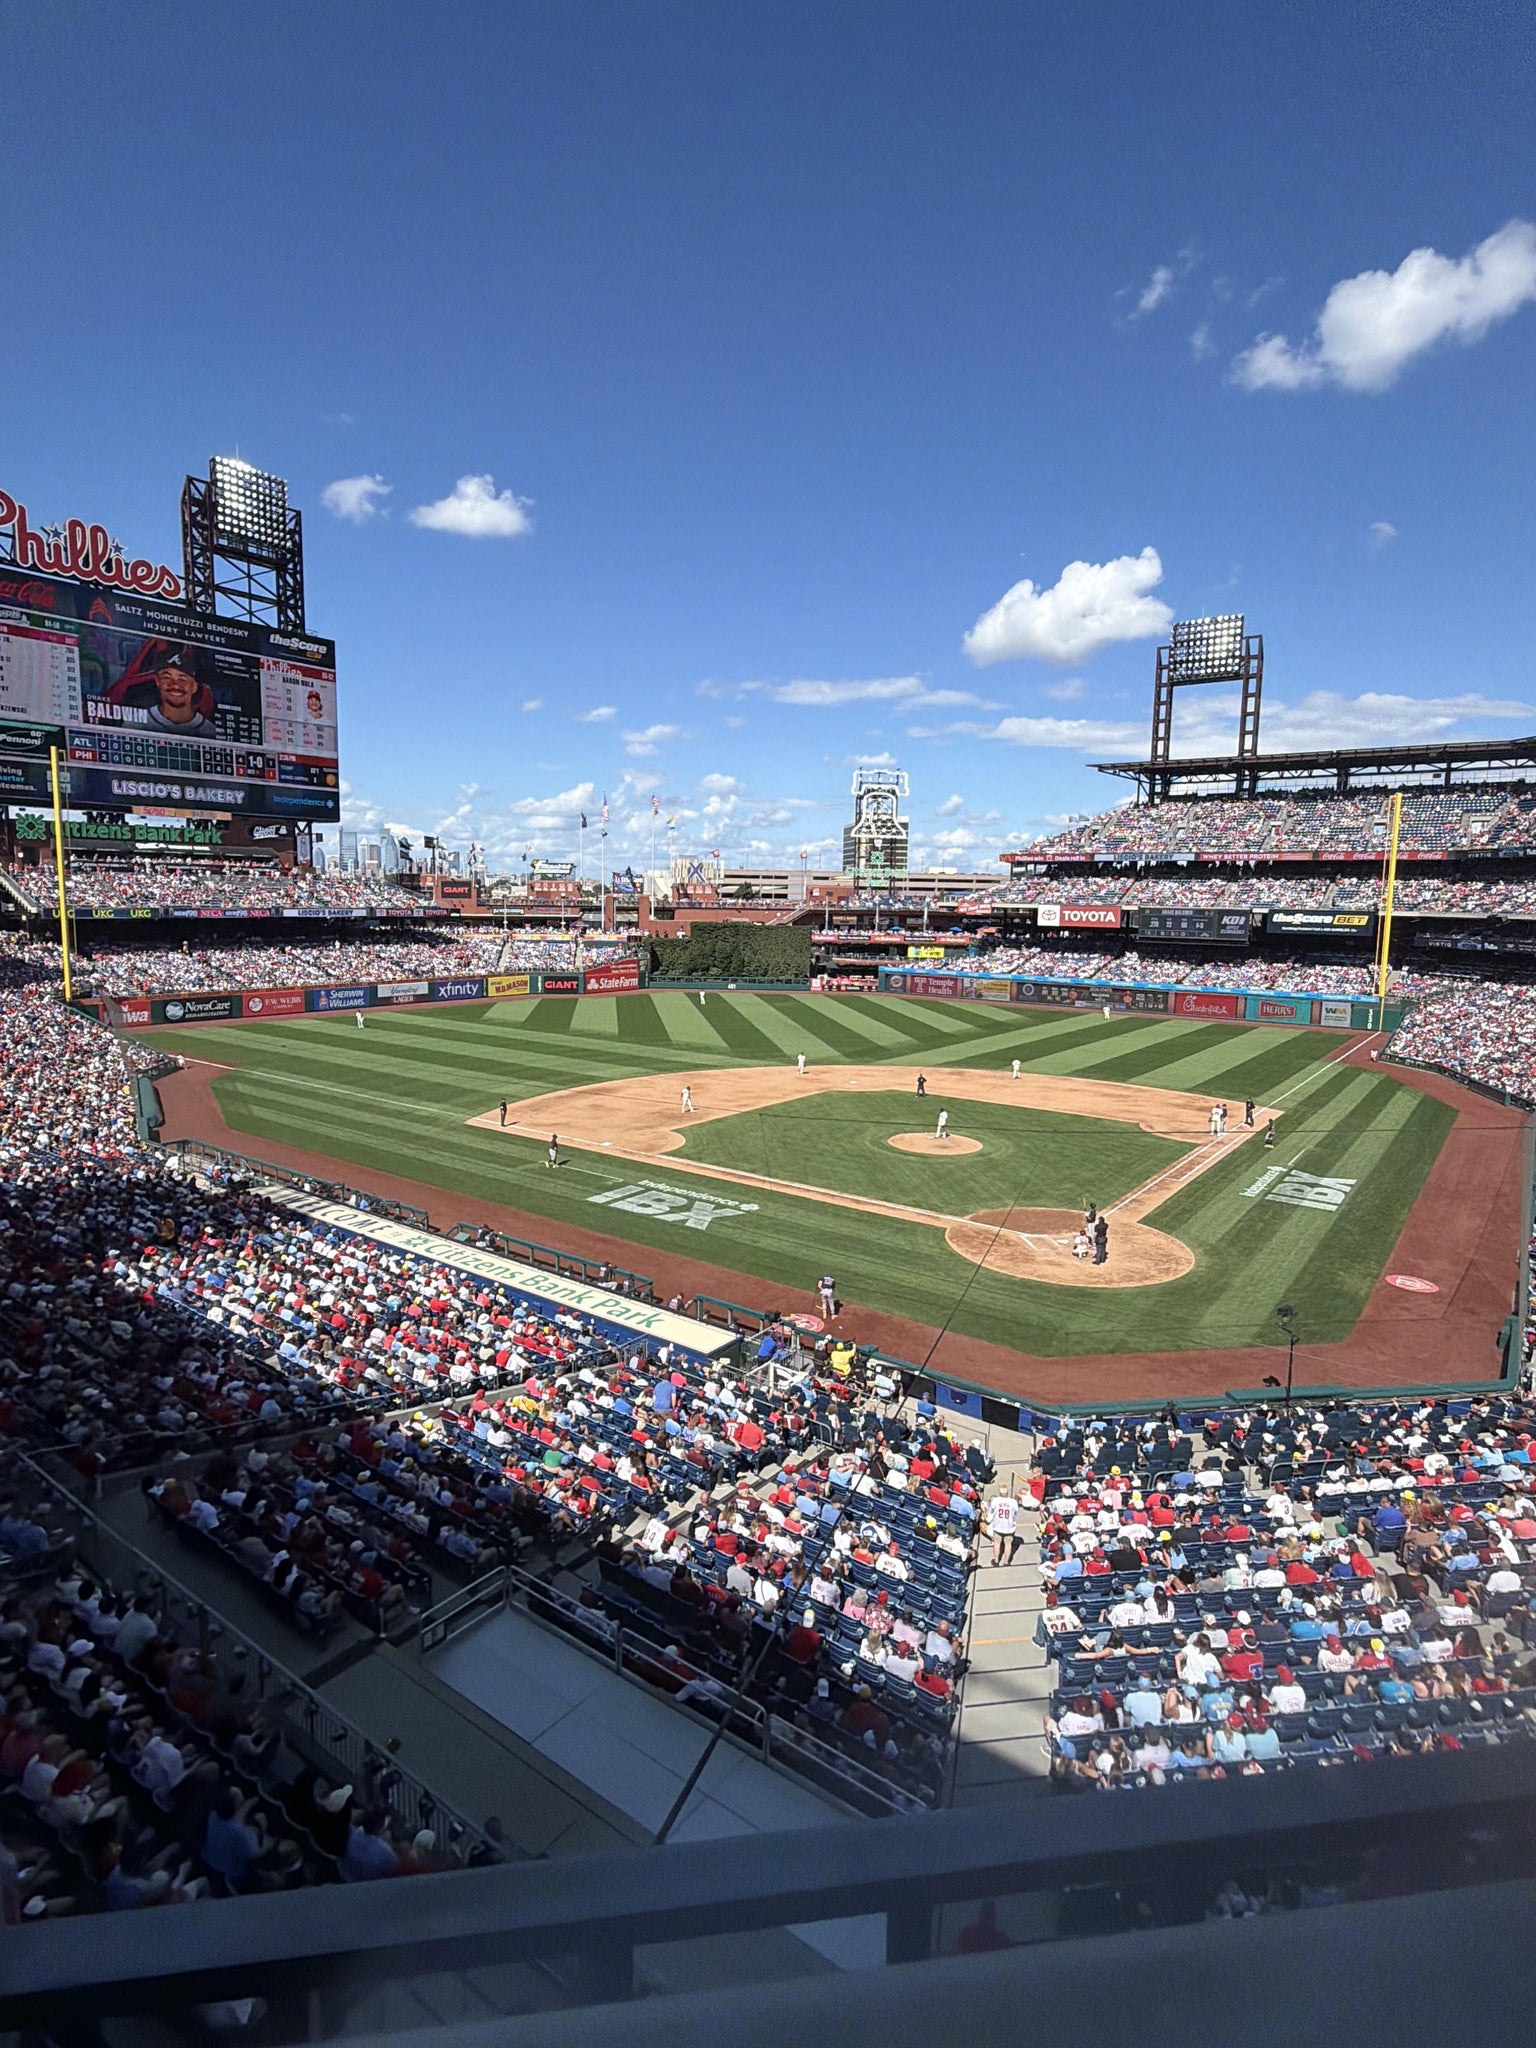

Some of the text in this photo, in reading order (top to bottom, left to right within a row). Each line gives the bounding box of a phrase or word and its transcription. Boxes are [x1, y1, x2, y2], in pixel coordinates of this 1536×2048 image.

[114, 603, 249, 638] SALTZ MONGELUZZI BENDESKY
[143, 621, 226, 644] INJURY LAWYERS
[269, 633, 327, 654] theScore
[86, 701, 148, 724] BALDWIN
[73, 737, 92, 747] ATL
[75, 751, 92, 760] PHI
[248, 755, 263, 768] 1-0
[112, 779, 245, 805] LISCIO'S BAKERY
[134, 825, 181, 842] Bank
[183, 827, 223, 844] Park
[1144, 853, 1173, 861] BAKERY
[1322, 852, 1345, 860] Coca-Cola
[1353, 852, 1376, 860] Coca-Cola
[1417, 851, 1442, 860] Coca-Cola
[443, 886, 469, 894] GIANT
[52, 909, 75, 918] UG
[92, 909, 114, 918] UKG
[130, 908, 151, 918] UKG
[249, 909, 271, 917] NECA
[1062, 910, 1116, 923] TOYOTA
[1272, 913, 1366, 924] theScore BET
[544, 981, 578, 989] GIANT
[599, 977, 638, 990] StateFarm
[928, 978, 955, 989] Temple
[330, 989, 364, 999] SHERWIN
[438, 982, 479, 998] xfinity
[928, 986, 953, 995] Health
[393, 996, 414, 1004] LAGER
[185, 1000, 231, 1013] NovaCare
[1263, 1004, 1292, 1016] HERR'S
[185, 1010, 230, 1019] REHABILITATION
[637, 1179, 740, 1207] Independence
[1264, 1169, 1358, 1212] IBX
[586, 1184, 747, 1231] IBX
[424, 1243, 666, 1330] Citizens Bank Park
[998, 1508, 1011, 1520] 28
[1284, 1504, 1290, 1515] 3
[1109, 1515, 1114, 1525] 3
[1242, 1577, 1249, 1588] 3
